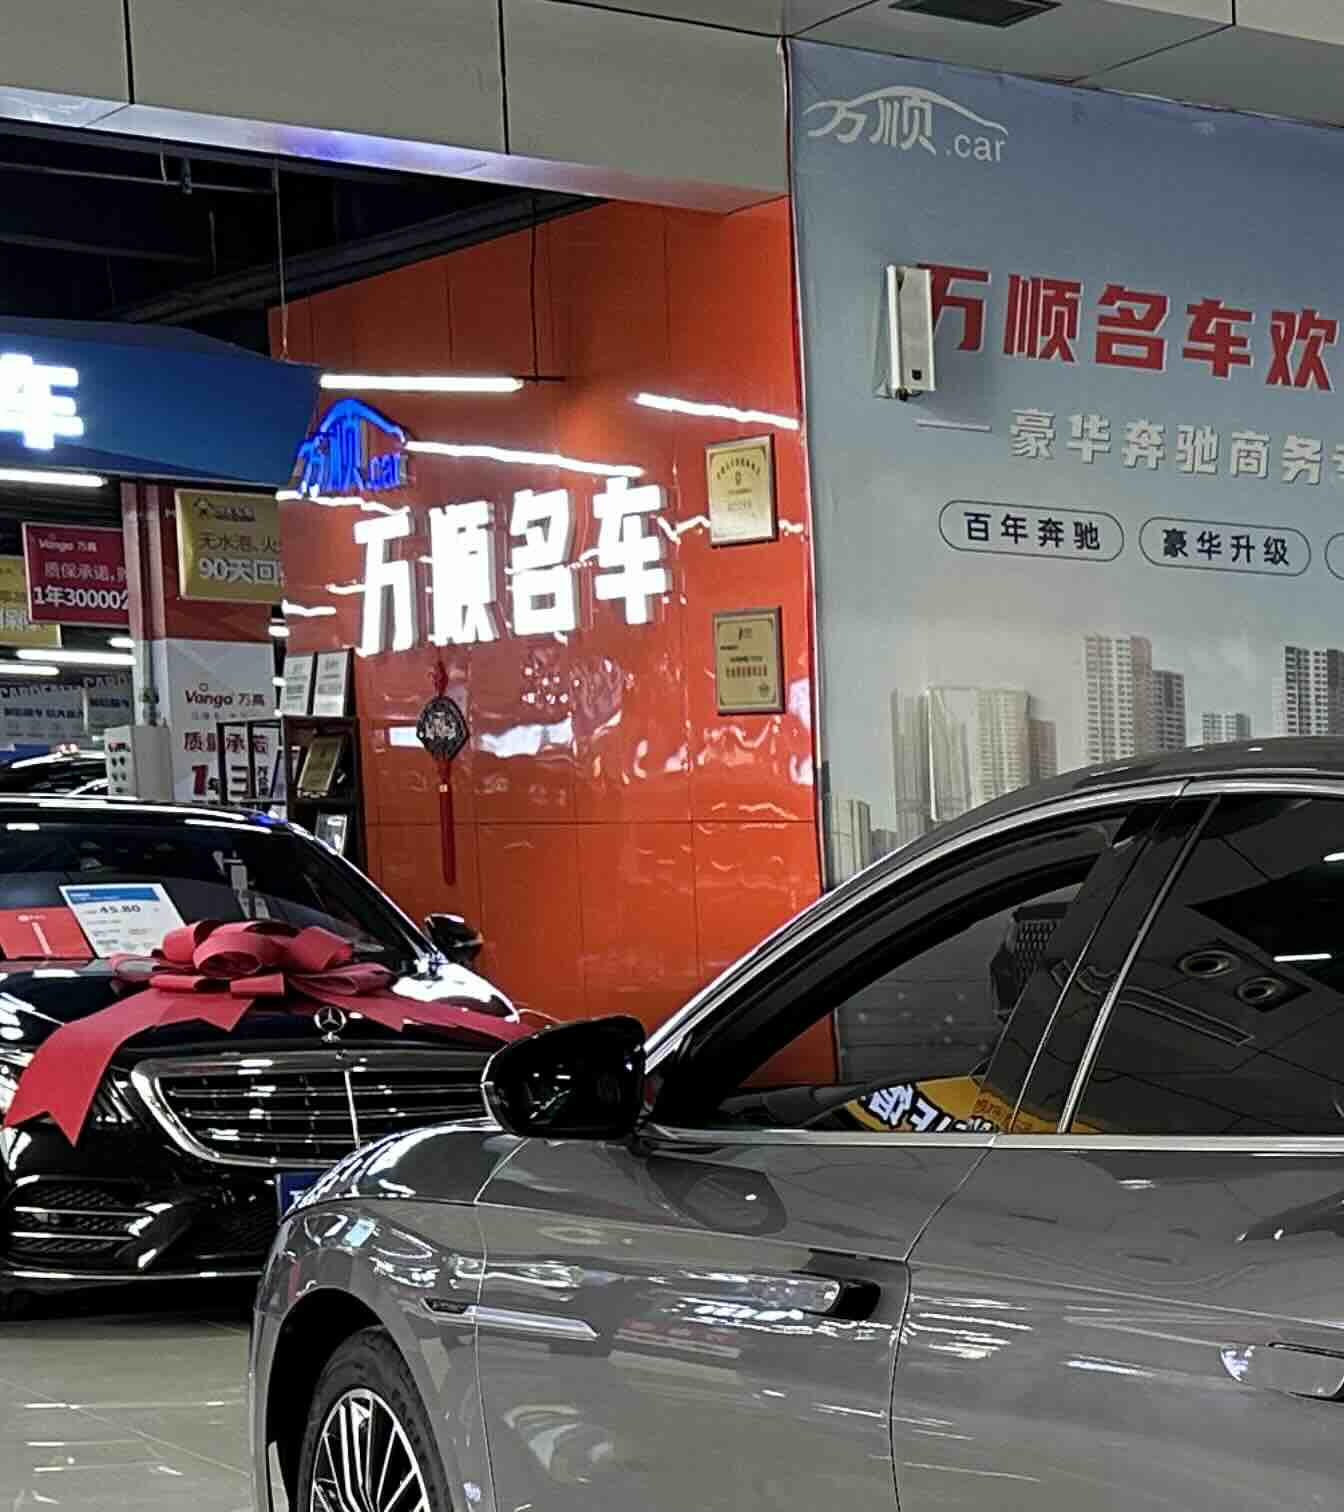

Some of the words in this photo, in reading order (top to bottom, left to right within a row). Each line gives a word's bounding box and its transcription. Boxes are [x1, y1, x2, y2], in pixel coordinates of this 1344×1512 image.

[944, 131, 1007, 164] .car
[963, 512, 1102, 552] 百年奔驰
[1162, 526, 1292, 568] 豪华升级
[354, 476, 668, 658] 万顺名车
[184, 689, 233, 709] Vango
